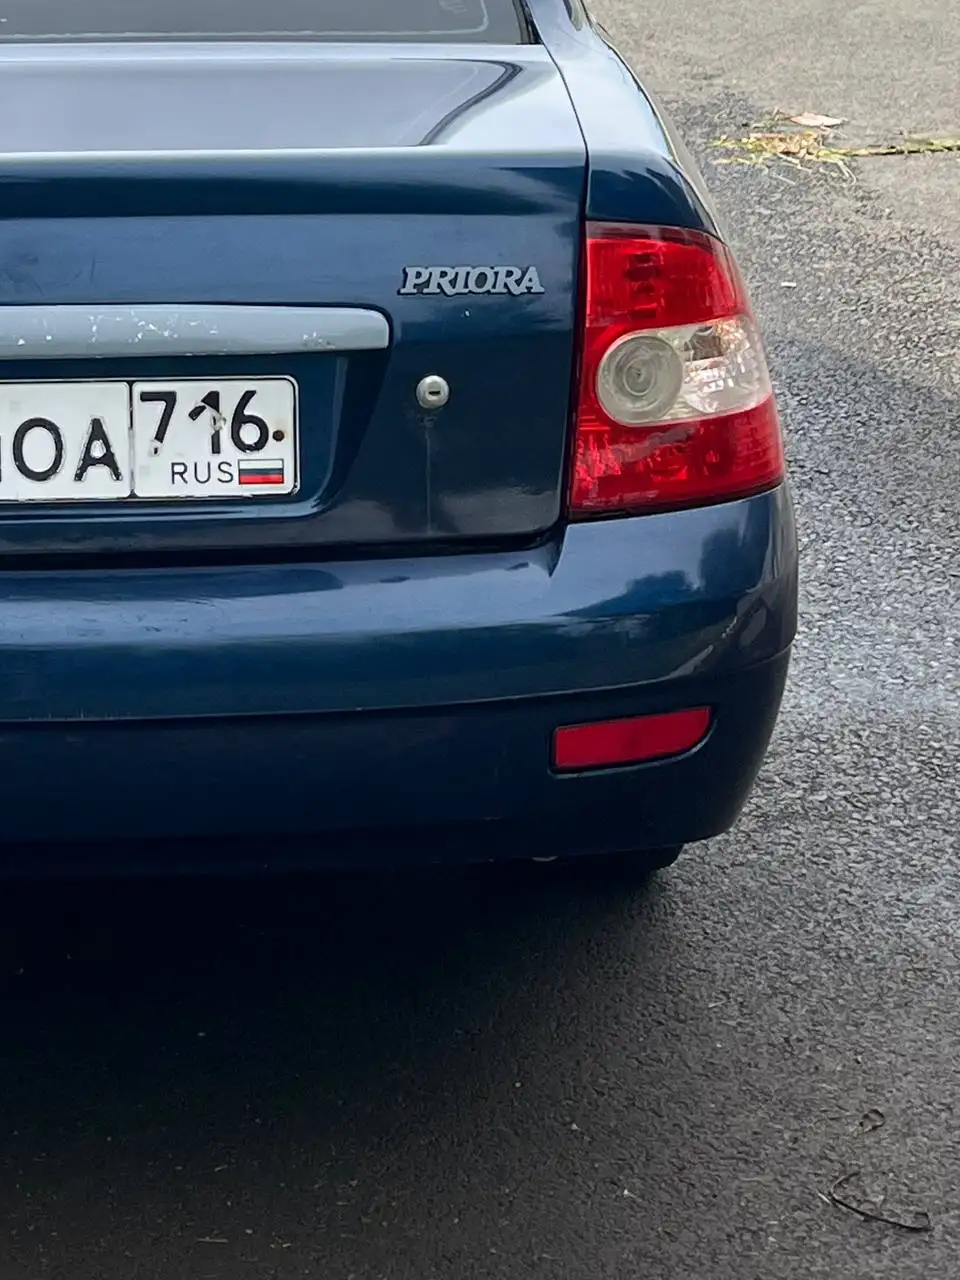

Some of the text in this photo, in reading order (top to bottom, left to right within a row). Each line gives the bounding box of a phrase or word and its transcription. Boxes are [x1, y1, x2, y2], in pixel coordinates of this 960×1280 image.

[398, 265, 545, 296] PRIORA
[140, 389, 270, 457] 716
[170, 461, 235, 485] RUS
